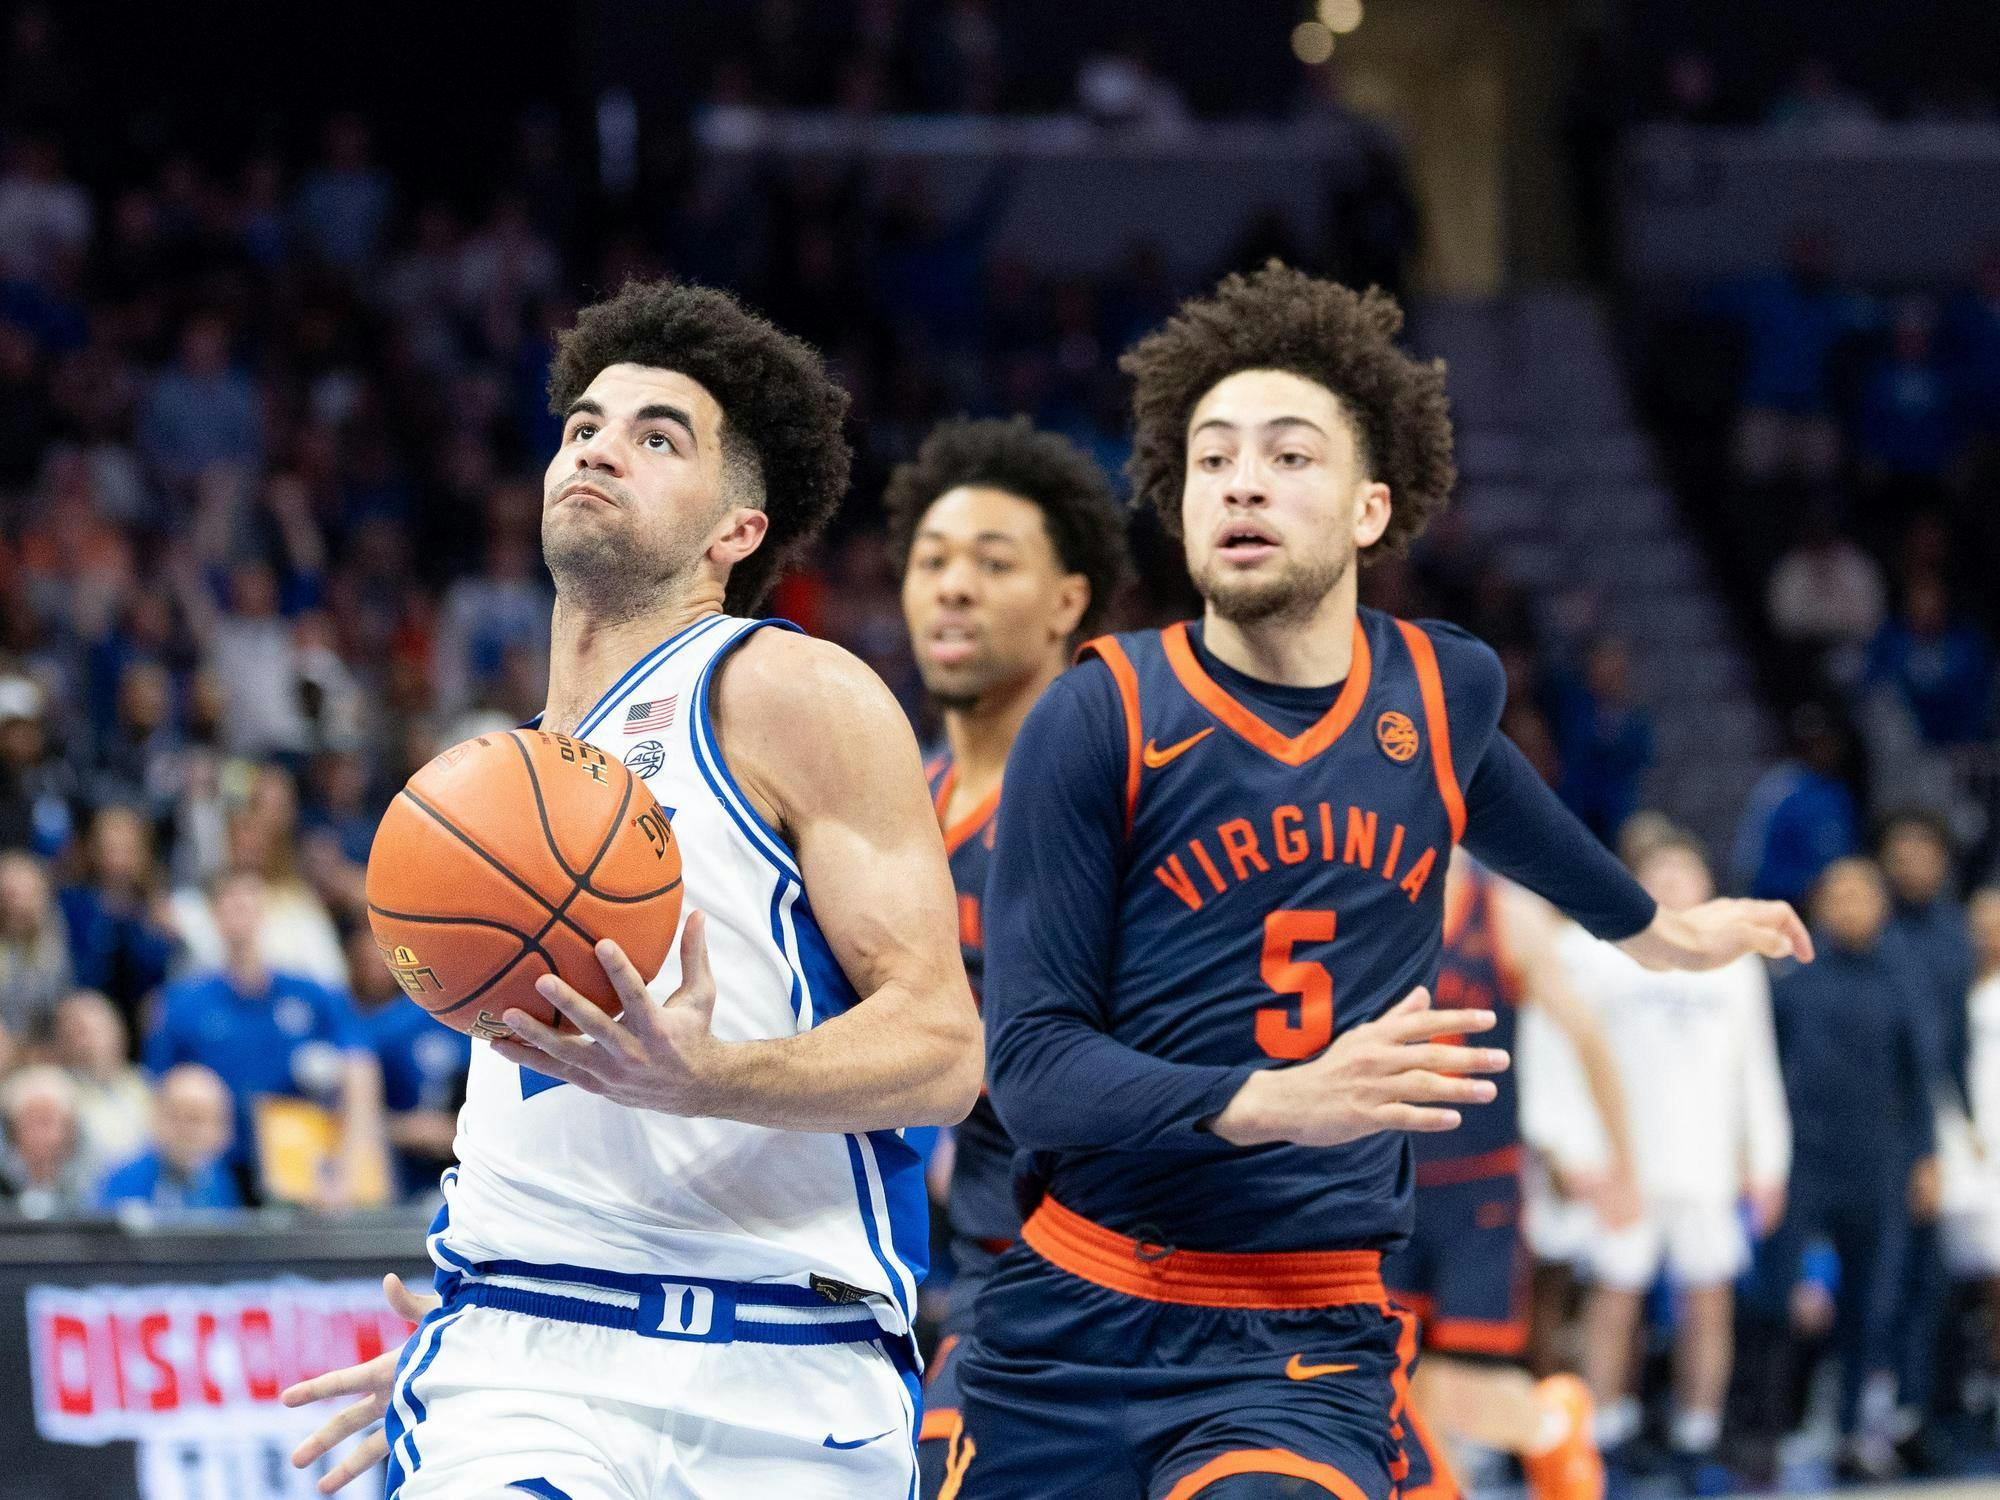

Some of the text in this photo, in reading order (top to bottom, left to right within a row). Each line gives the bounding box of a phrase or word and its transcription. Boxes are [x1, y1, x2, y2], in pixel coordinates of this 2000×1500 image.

[1154, 803, 1437, 911] VIRGINIA
[1254, 909, 1337, 1060] 5
[656, 1282, 714, 1335] D
